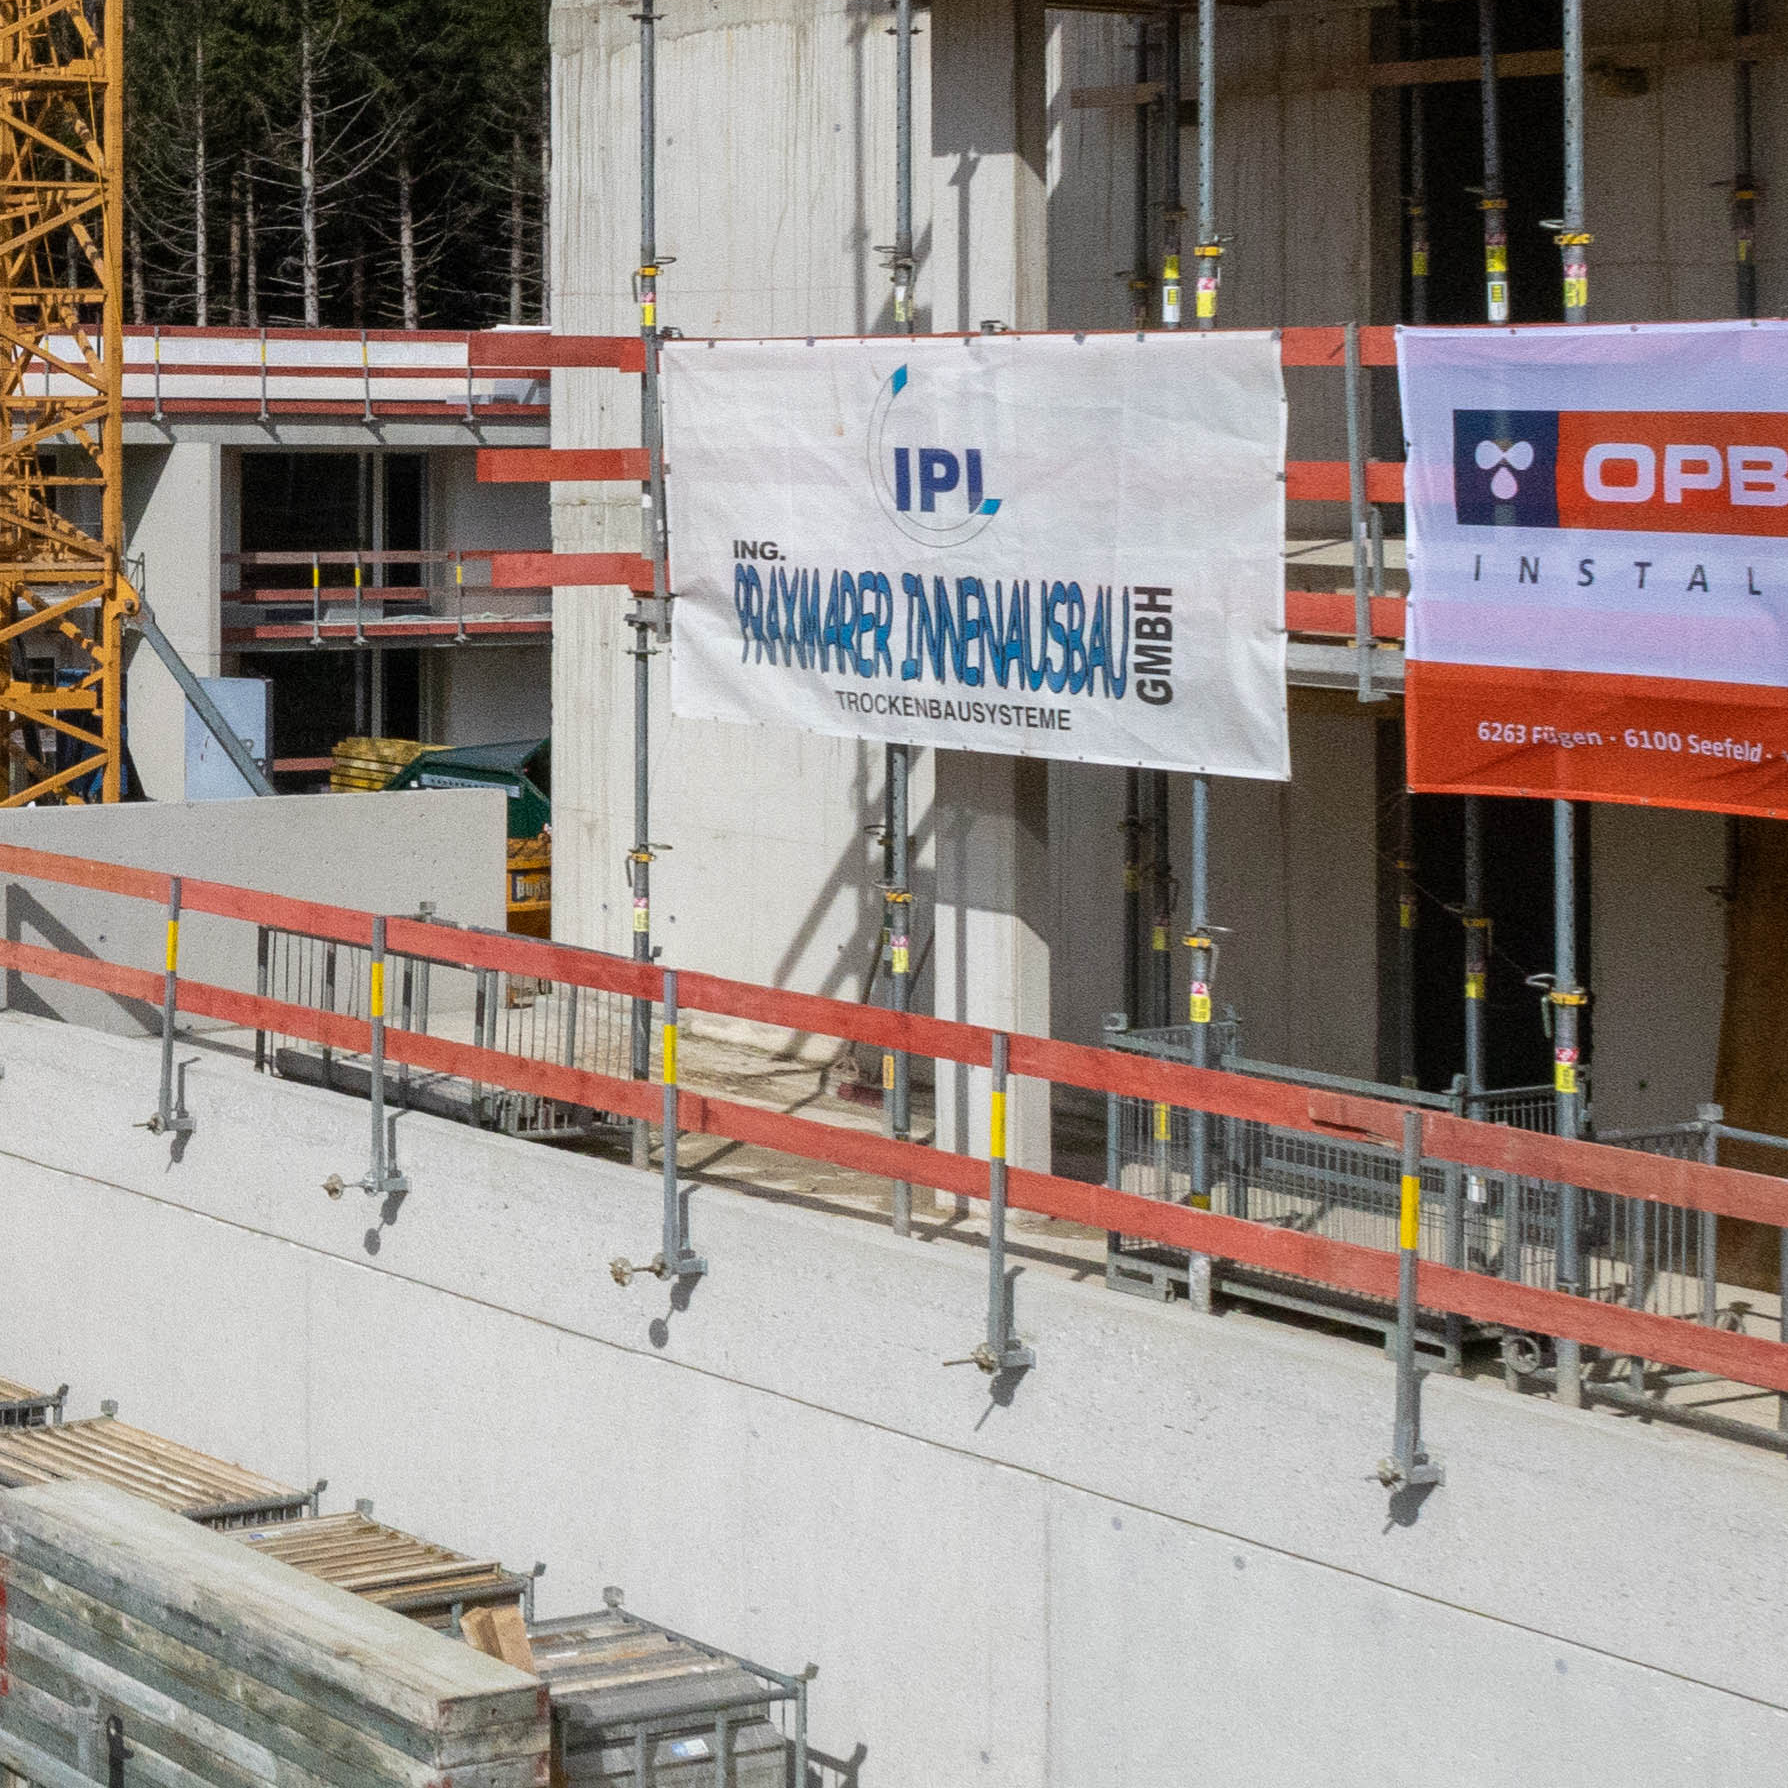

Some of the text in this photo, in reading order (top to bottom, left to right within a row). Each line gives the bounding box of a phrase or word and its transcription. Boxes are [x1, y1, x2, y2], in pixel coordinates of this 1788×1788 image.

[1582, 442, 1788, 507] OPB
[733, 539, 787, 562] ING.
[734, 562, 1130, 701] PRAXMARER INNENAUSBAU
[1134, 585, 1174, 707] GMBH
[835, 689, 1073, 732] TROCKENBAUSYSTEME
[1477, 721, 1526, 745] 6263
[1531, 723, 1604, 750] Fügen
[1624, 728, 1682, 754] 6100
[1687, 733, 1762, 764] Seefeld
